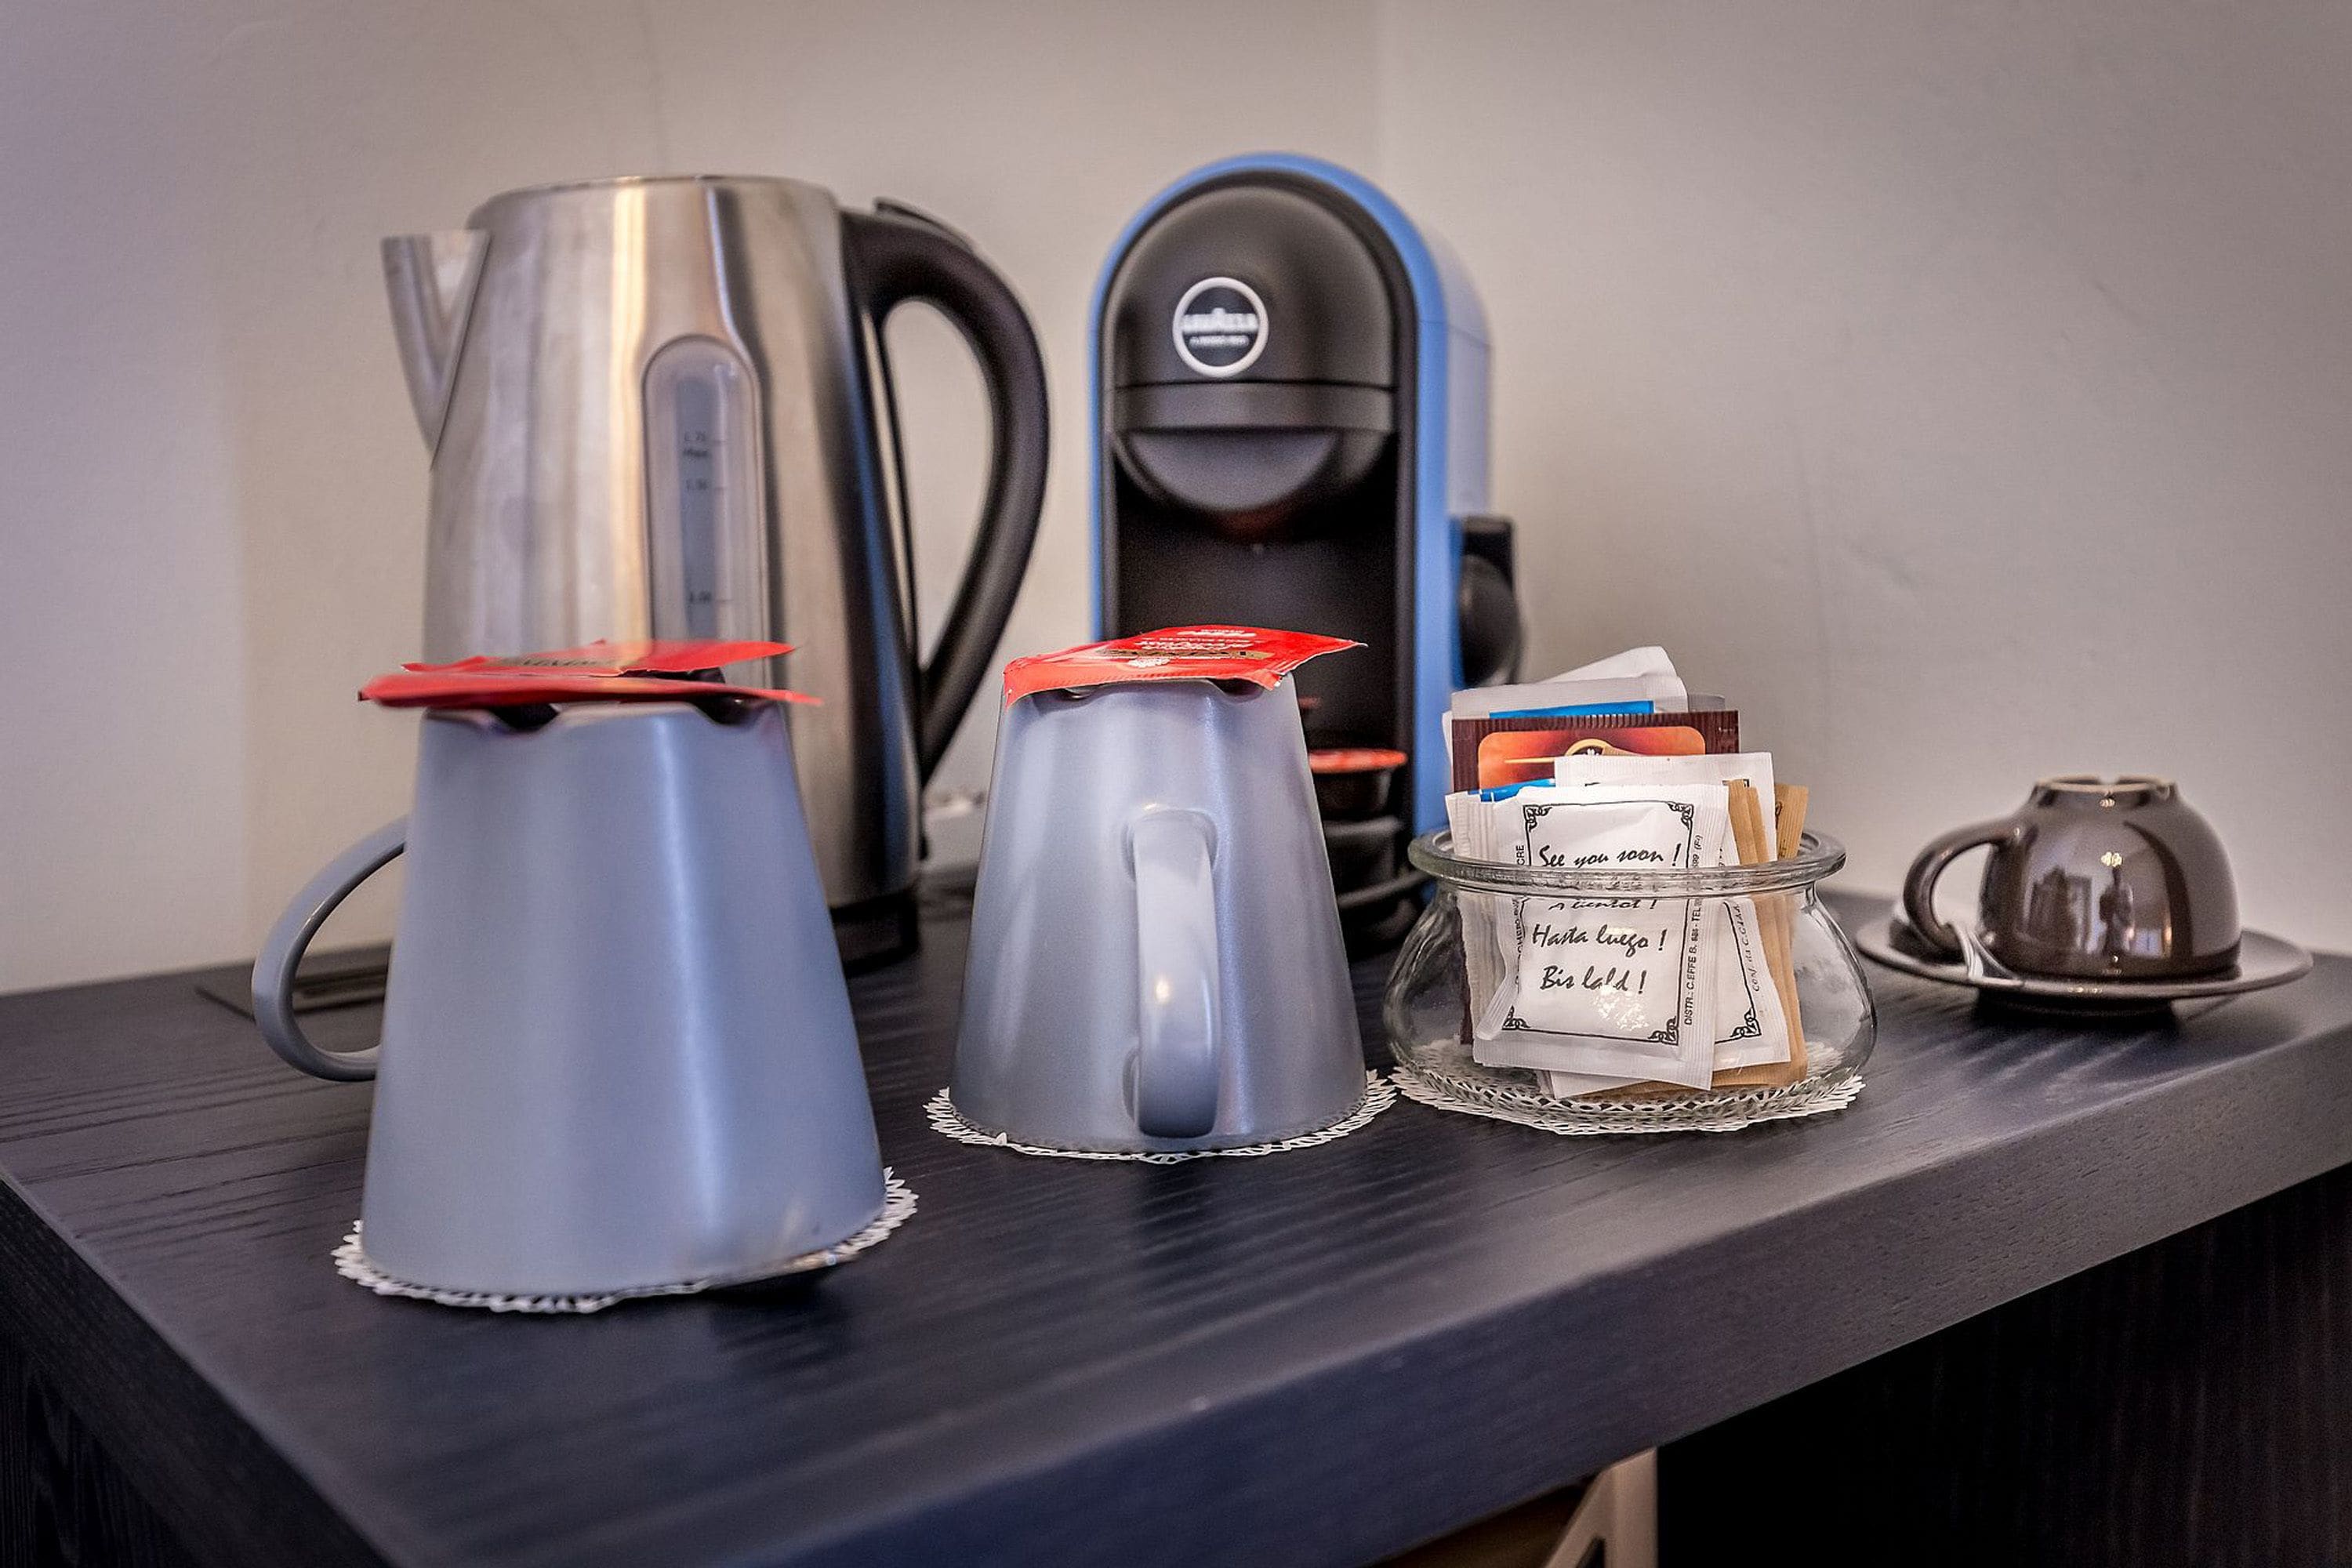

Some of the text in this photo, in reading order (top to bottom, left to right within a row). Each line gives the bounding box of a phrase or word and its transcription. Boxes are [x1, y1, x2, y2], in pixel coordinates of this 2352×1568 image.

[1539, 844, 1565, 866] See
[1573, 852, 1609, 868] you
[1617, 848, 1664, 862] soon
[1532, 924, 1588, 948] Hasta
[1595, 924, 1649, 958] luego
[1540, 964, 1574, 990] Bis
